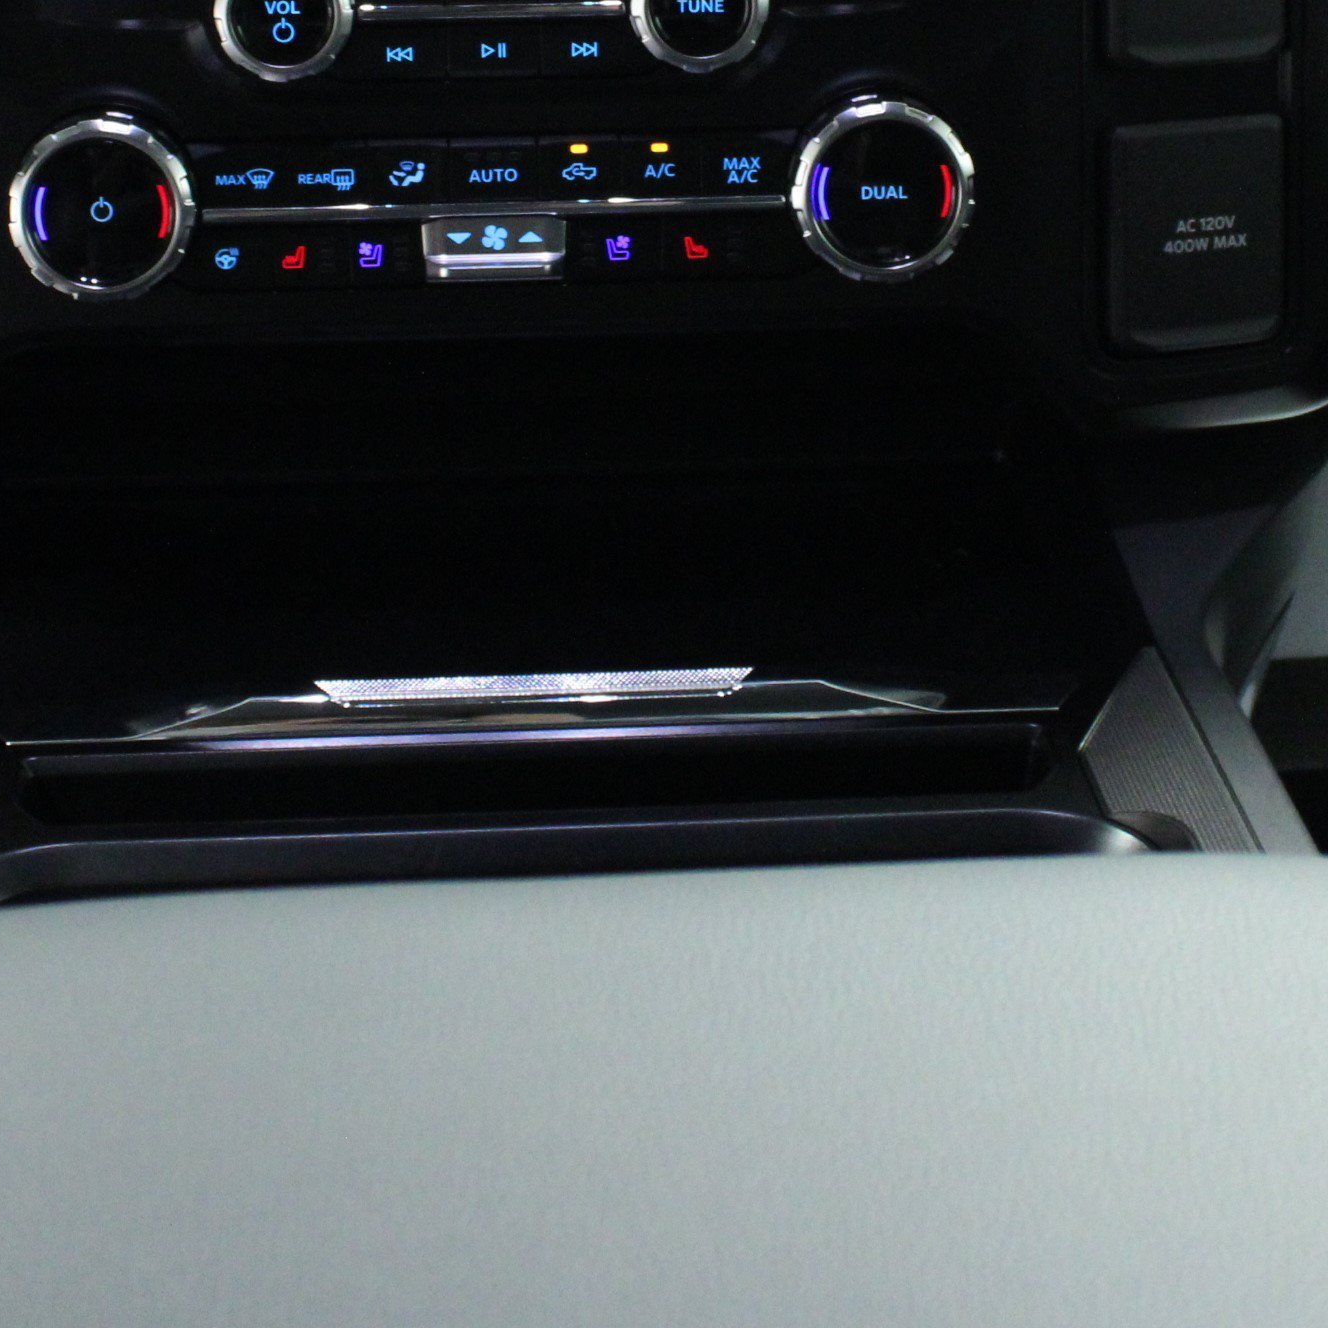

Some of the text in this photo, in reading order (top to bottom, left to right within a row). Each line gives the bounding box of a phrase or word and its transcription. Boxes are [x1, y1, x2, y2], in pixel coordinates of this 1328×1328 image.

[264, 0, 300, 16] VOL
[644, 163, 677, 179] A/C
[722, 156, 761, 171] MAX
[215, 174, 247, 186] MAX
[297, 173, 332, 185] REAR
[469, 168, 518, 184] AUTO
[727, 170, 759, 185] A/C
[860, 185, 909, 201] DUAL
[1176, 215, 1236, 233] AC 120V
[1163, 232, 1248, 254] 400W MAX
